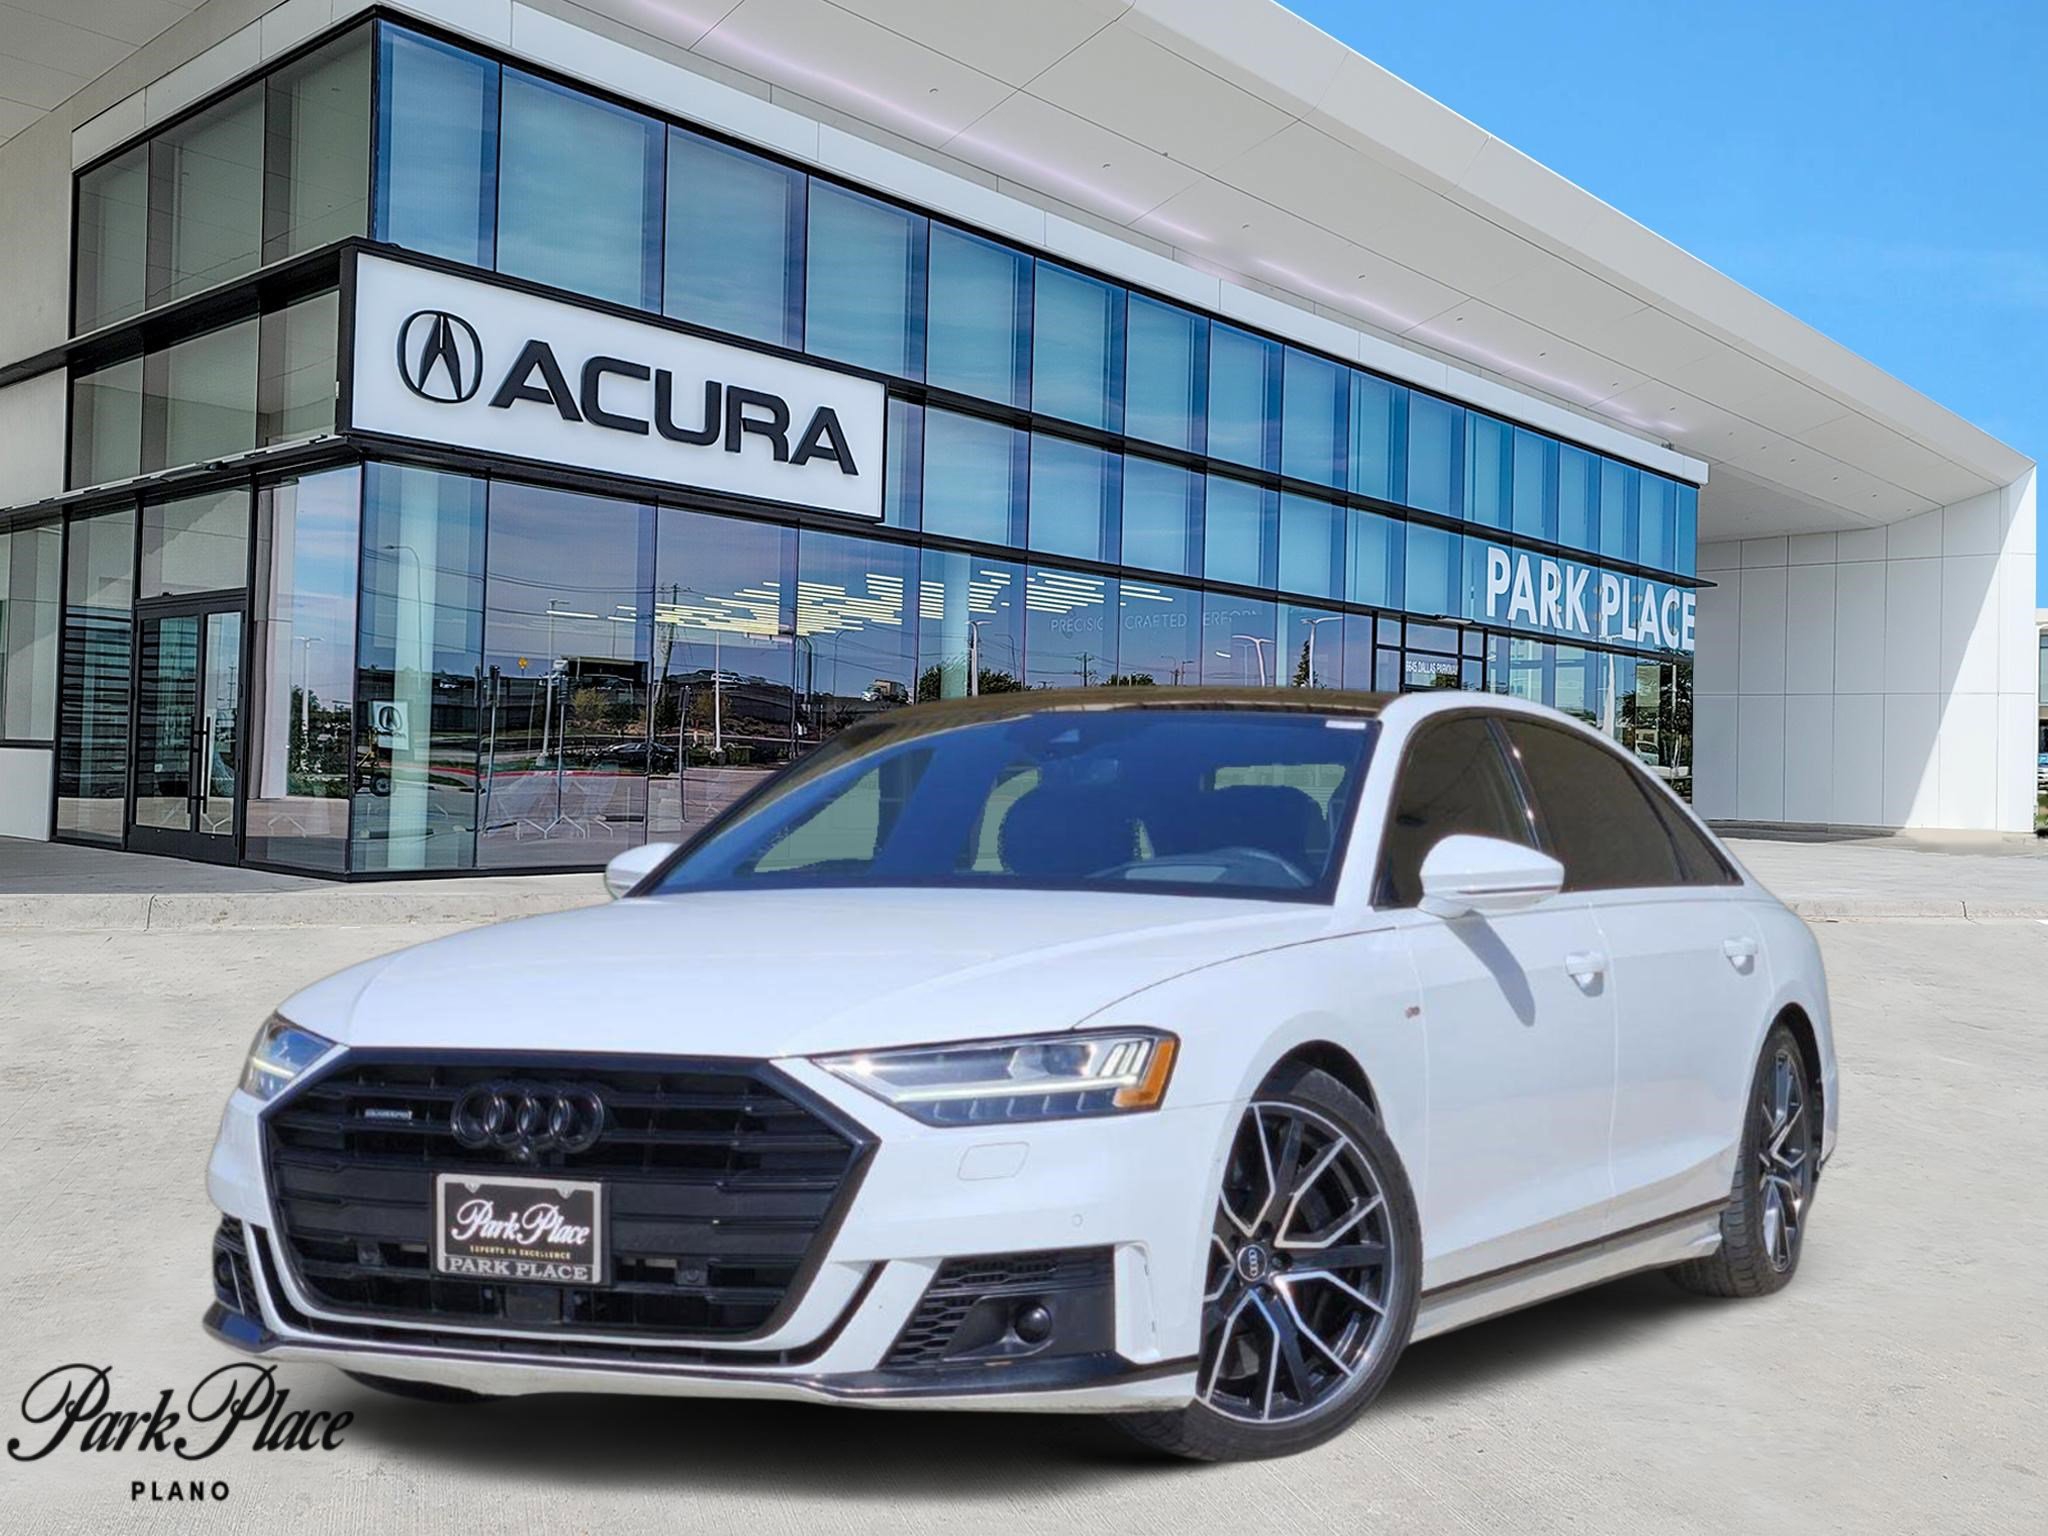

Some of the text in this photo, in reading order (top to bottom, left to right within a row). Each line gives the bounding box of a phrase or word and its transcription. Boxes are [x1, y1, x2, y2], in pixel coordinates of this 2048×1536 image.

[488, 340, 859, 476] ACURA
[1486, 546, 1696, 650] PARK PLACE
[1125, 613, 1188, 630] CRAFTED
[451, 1199, 590, 1245] Park Place
[450, 1257, 588, 1280] PARK PLACE
[519, 1249, 572, 1260] EXCELLENCE
